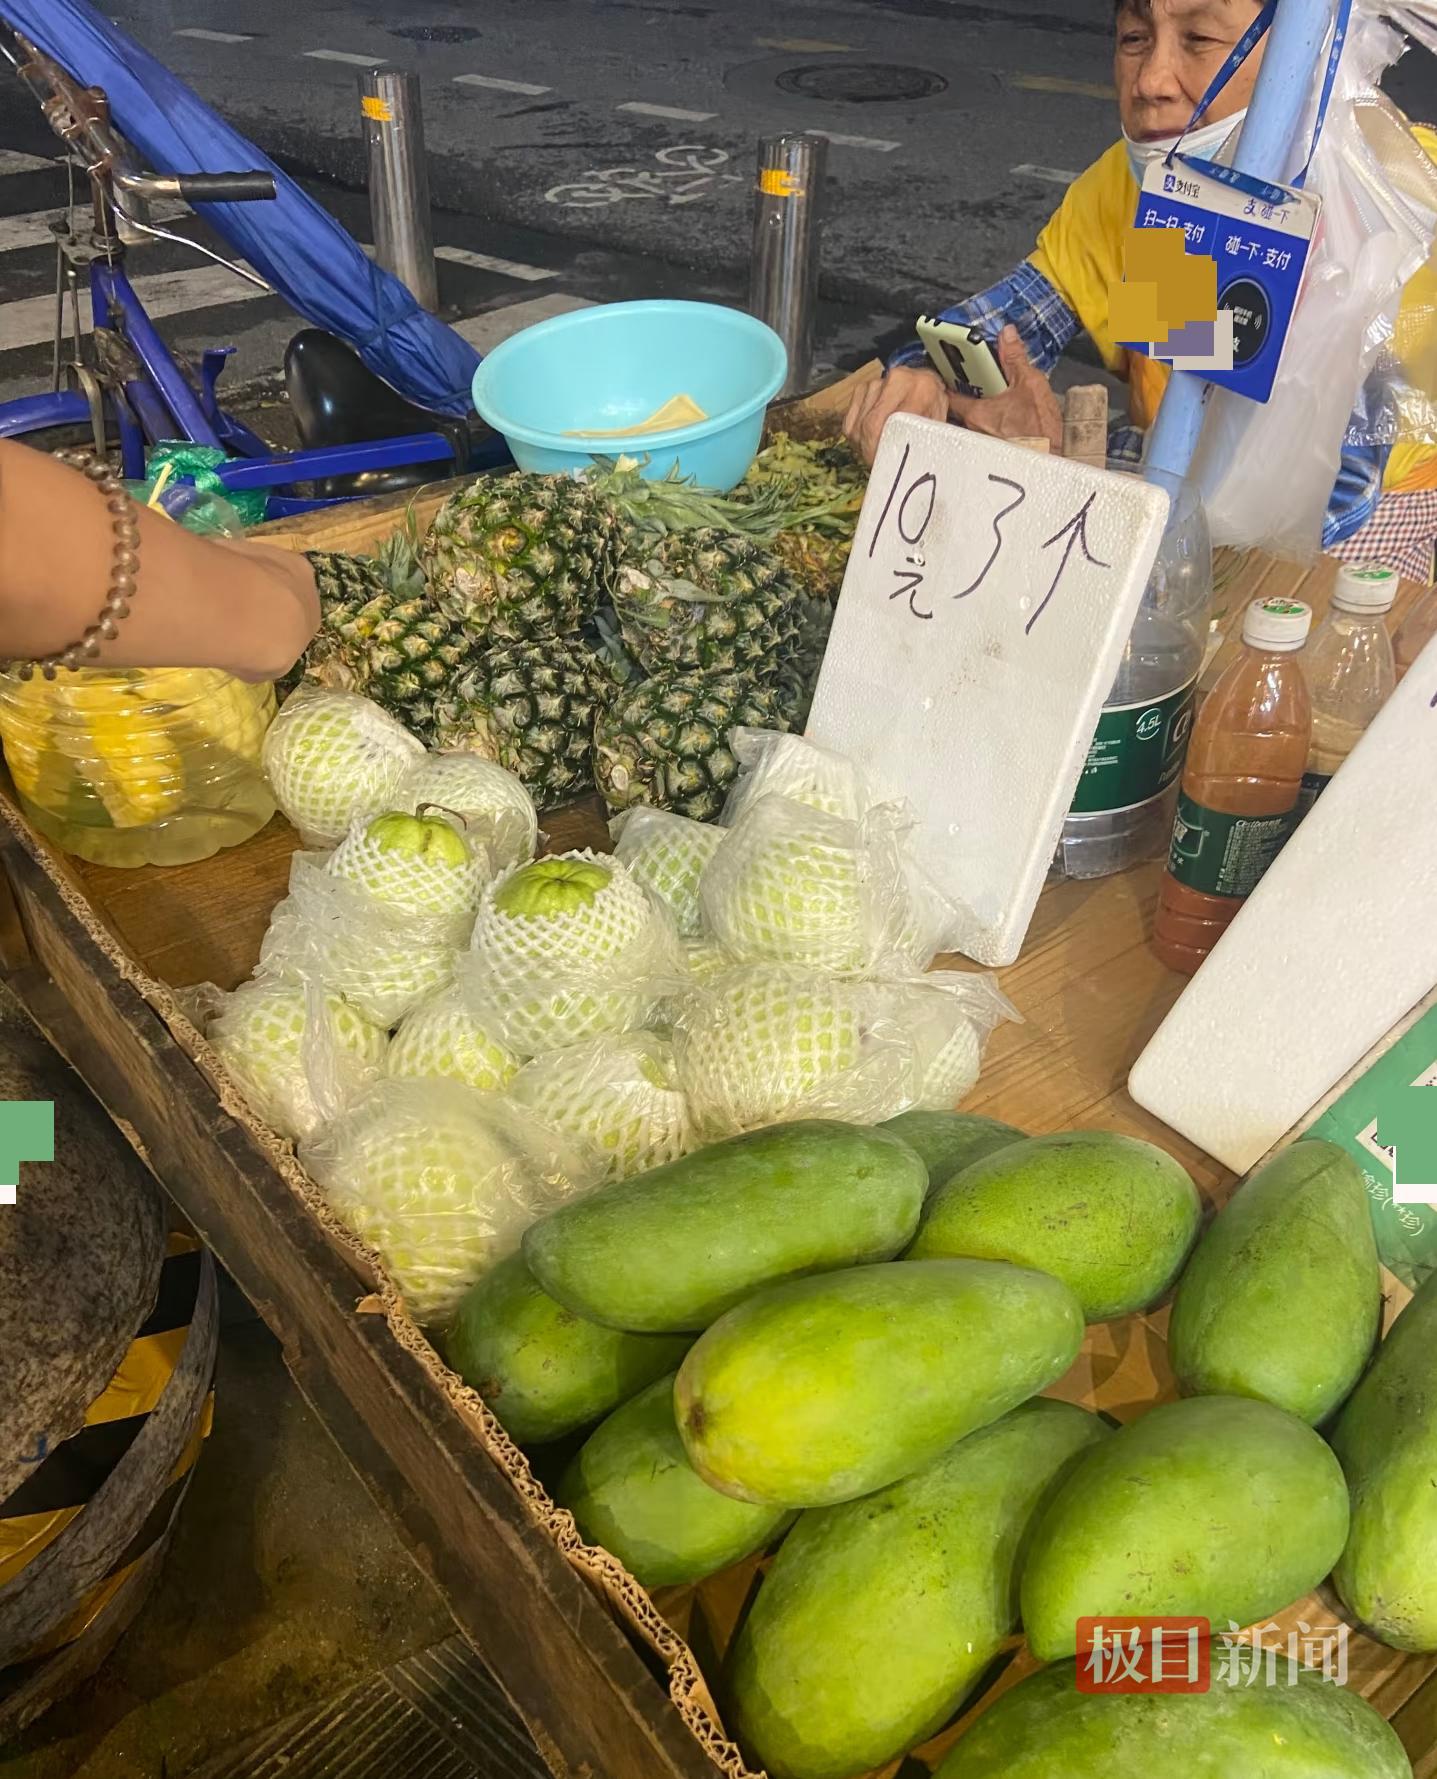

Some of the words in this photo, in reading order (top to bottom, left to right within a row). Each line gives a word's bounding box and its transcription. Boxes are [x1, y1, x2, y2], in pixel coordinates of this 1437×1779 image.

[1176, 179, 1200, 198] 支付宝
[1260, 203, 1290, 225] 碰一下
[1136, 714, 1162, 735] 4.5L
